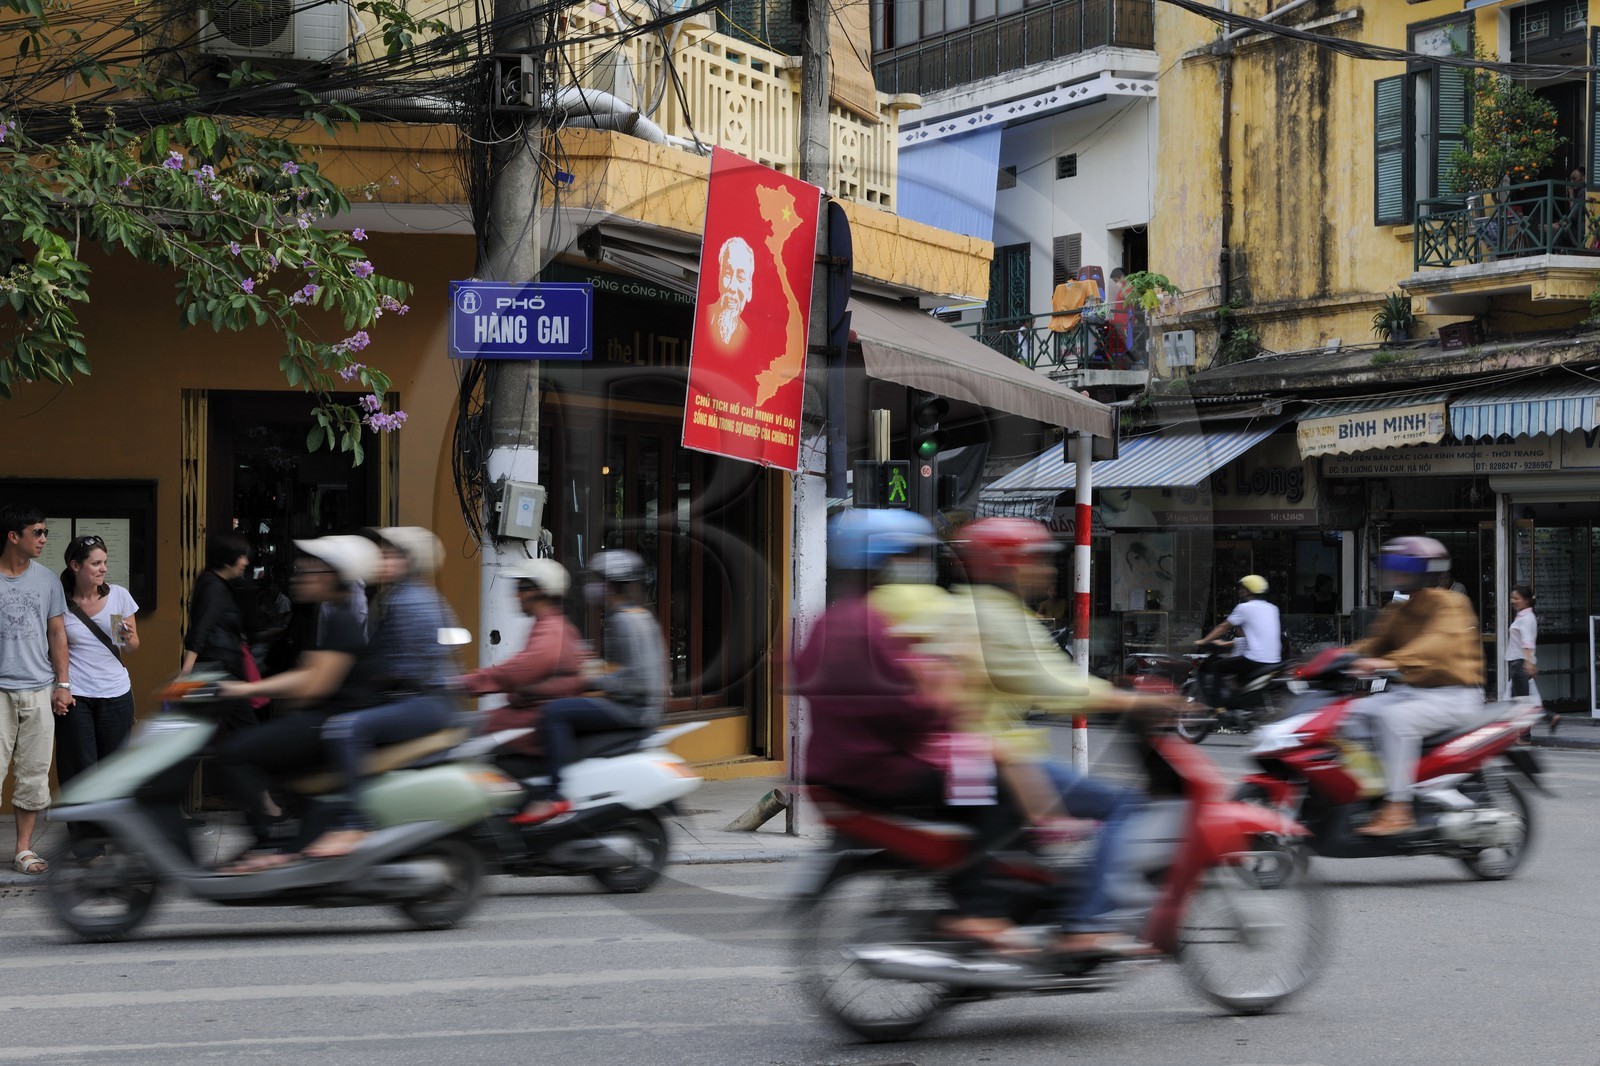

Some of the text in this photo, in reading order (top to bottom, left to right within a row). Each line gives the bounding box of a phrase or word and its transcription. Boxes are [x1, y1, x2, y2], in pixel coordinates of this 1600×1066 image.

[496, 295, 546, 310] PHỐ
[621, 282, 657, 298] CÔNG
[658, 290, 671, 301] TY
[474, 312, 570, 345] HÀNG GAI
[693, 408, 708, 425] SỐNG
[695, 393, 711, 408] CHỦ
[712, 398, 729, 414] TỊCH
[741, 405, 754, 418] CHÍ
[755, 409, 774, 424] MINH
[783, 417, 796, 431] ĐẠI
[1338, 419, 1377, 440] BÌNH
[1383, 412, 1426, 434] MINH
[1392, 451, 1411, 462] CÁC
[1434, 449, 1455, 460] KÍNH
[1456, 451, 1482, 460] MODE
[1491, 449, 1512, 459] THỜI
[1514, 449, 1545, 459] TRANG
[1234, 459, 1305, 503] Long
